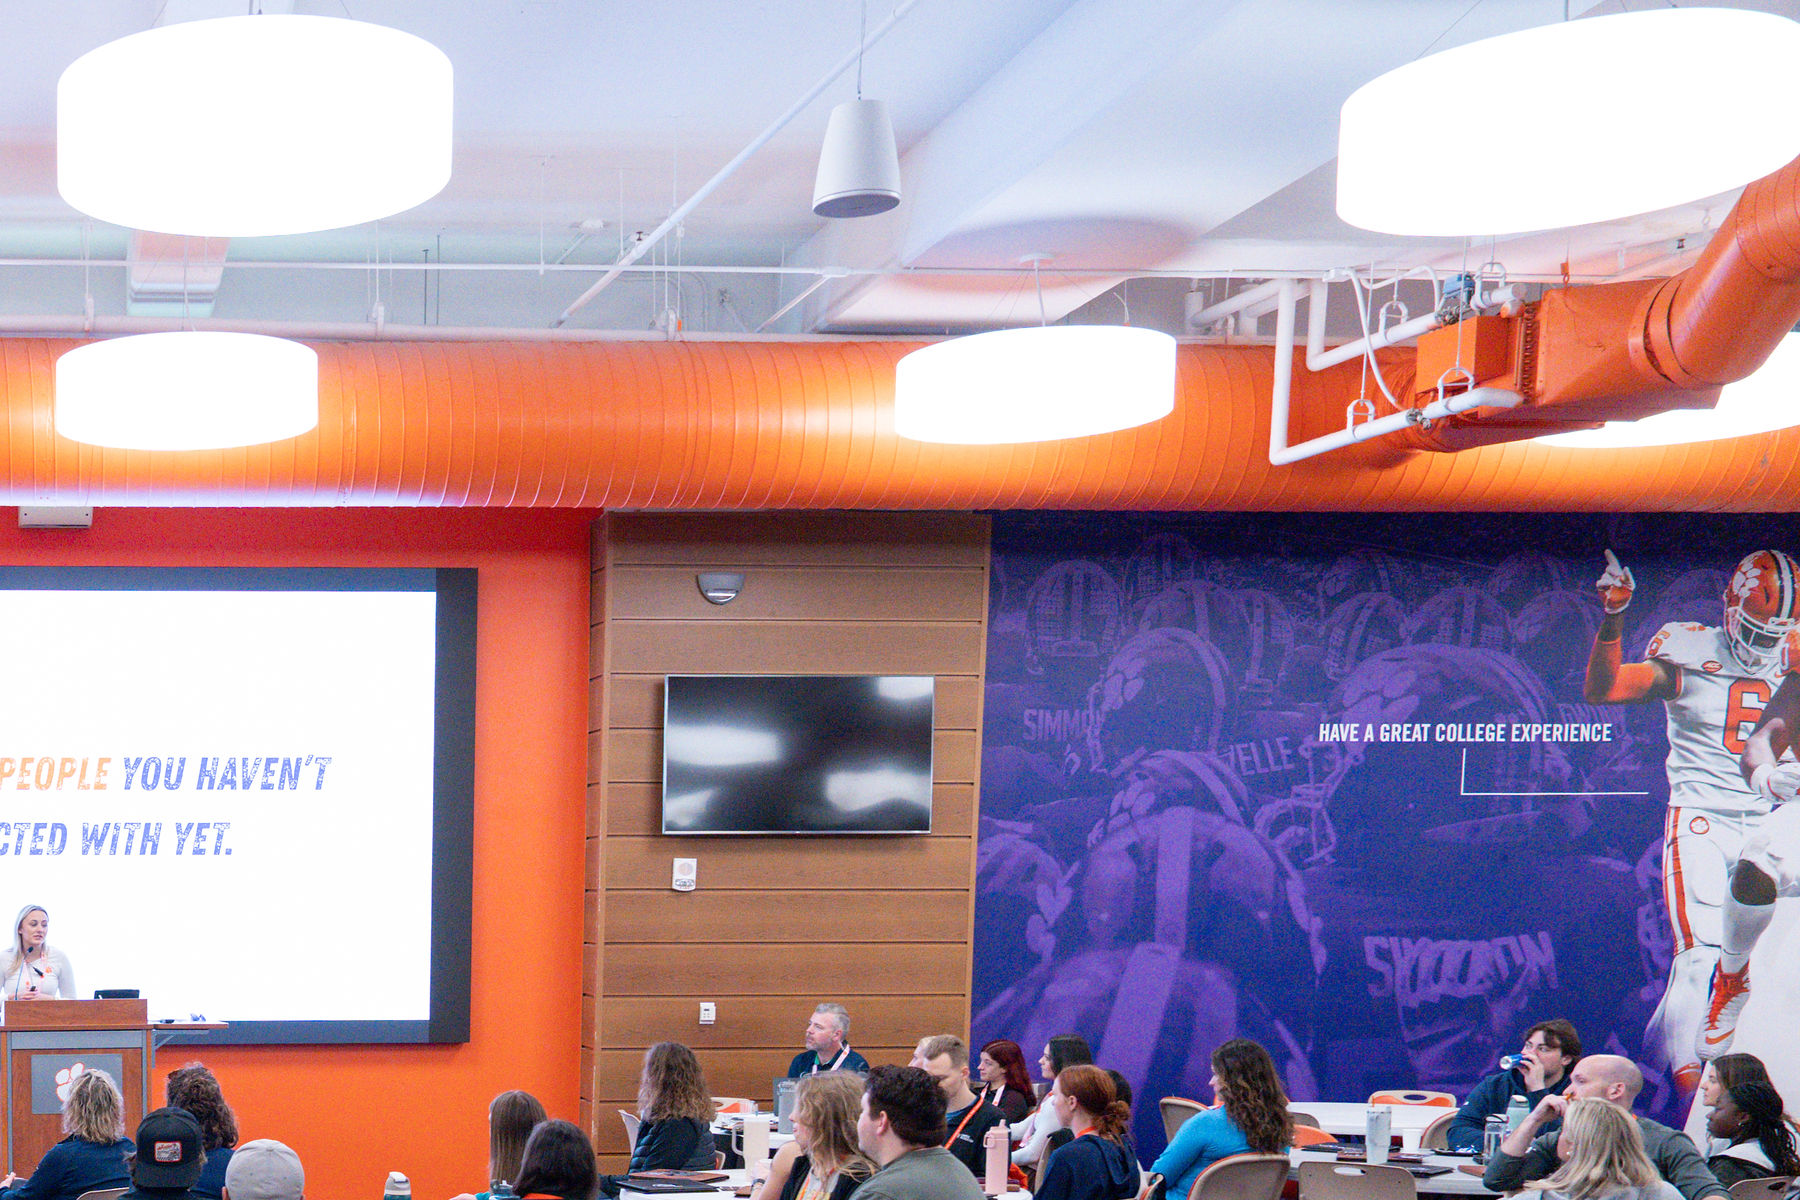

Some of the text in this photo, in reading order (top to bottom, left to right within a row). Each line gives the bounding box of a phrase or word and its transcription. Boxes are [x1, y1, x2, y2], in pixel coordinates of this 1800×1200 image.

[1318, 723, 1612, 742] HAVE A GREAT COLLEGE EXPERIENCE
[123, 756, 186, 791] YOU
[196, 754, 332, 791] HAVEN'T
[80, 821, 163, 856] WITH
[175, 821, 233, 856] YET.
